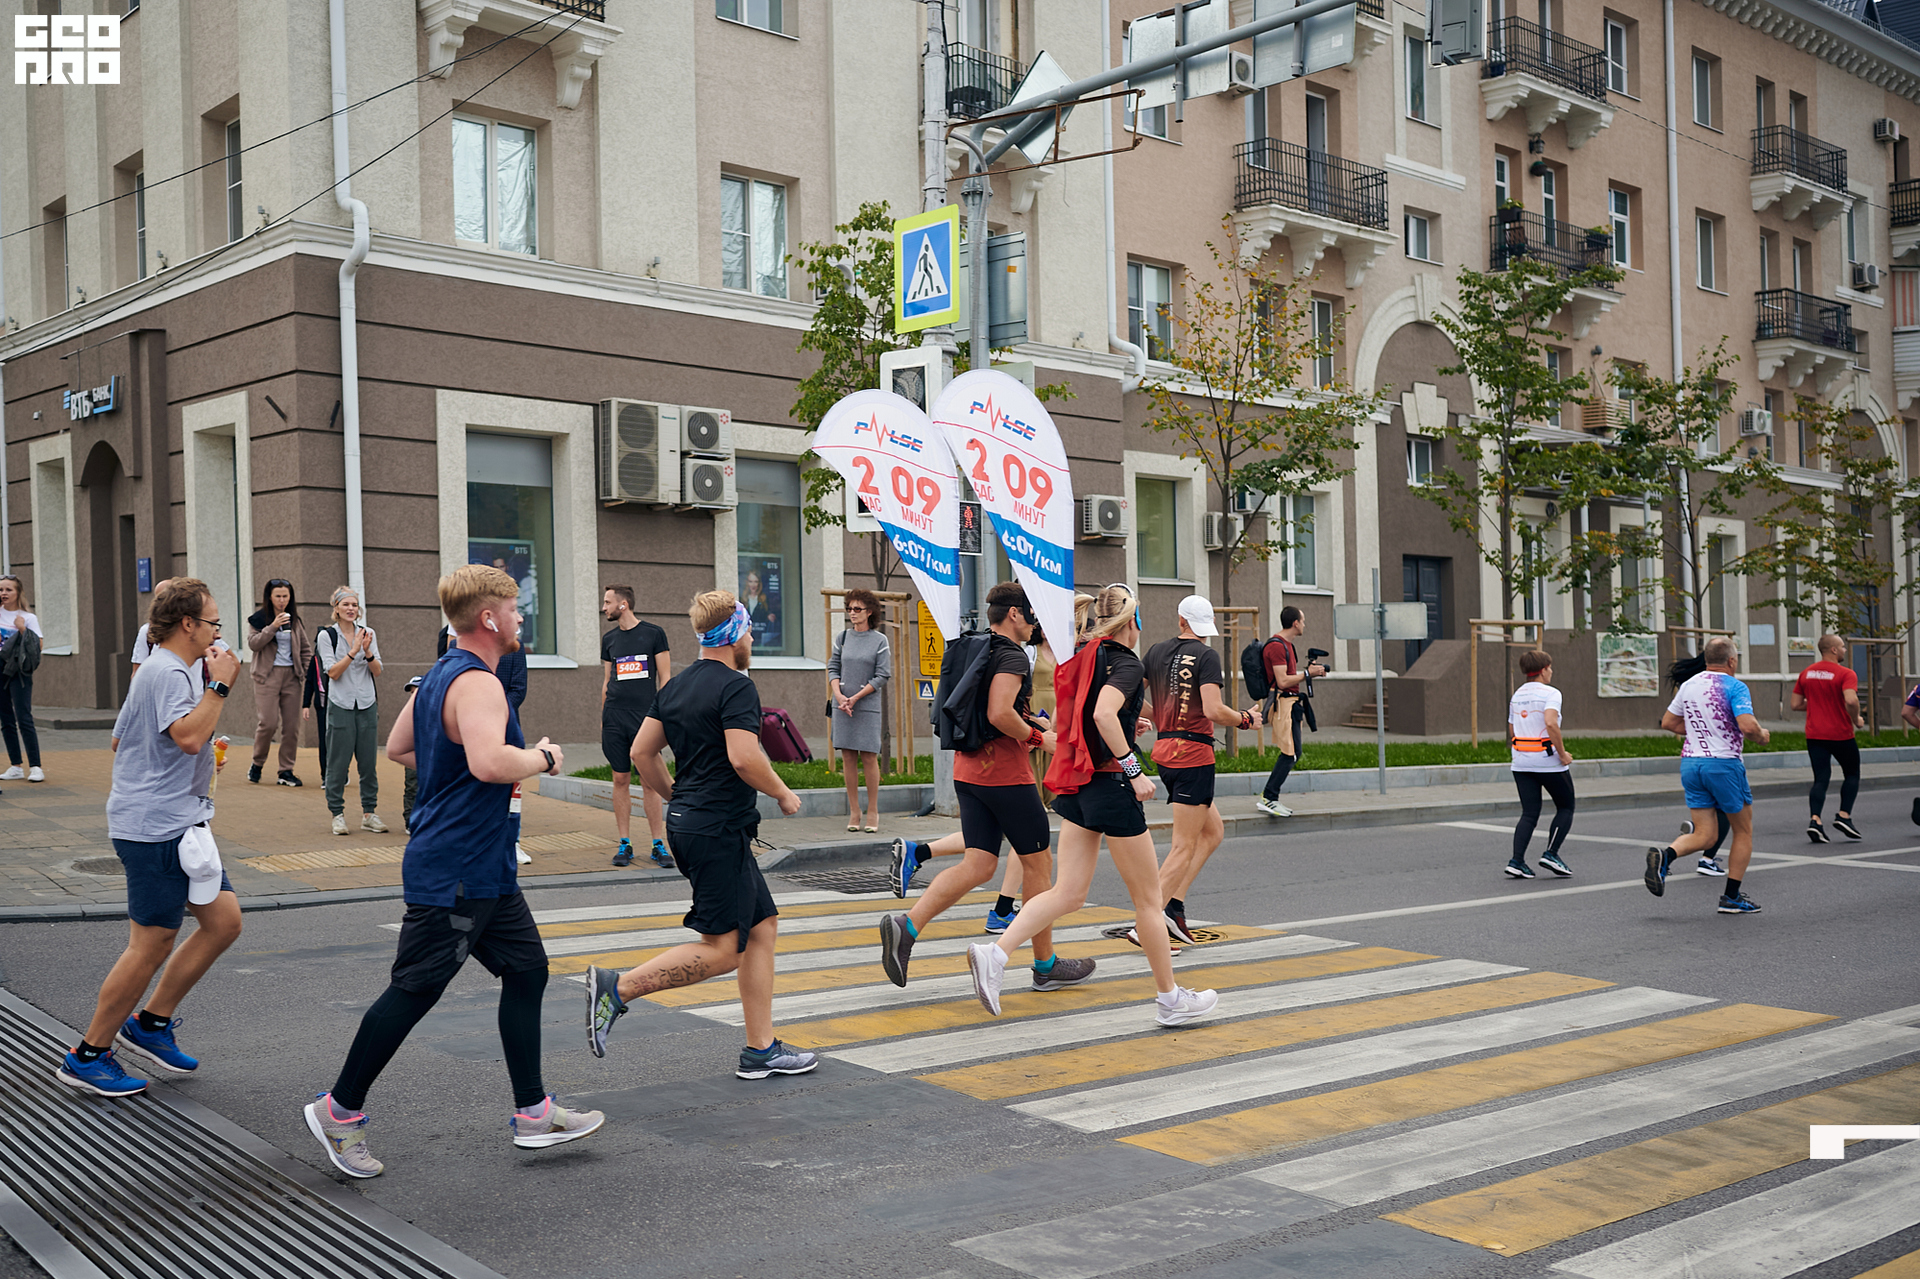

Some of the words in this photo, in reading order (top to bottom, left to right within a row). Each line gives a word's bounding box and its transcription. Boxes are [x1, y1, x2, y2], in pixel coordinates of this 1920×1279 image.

[70, 390, 92, 420] ВТБ
[92, 384, 111, 402] БАНК
[852, 455, 880, 496] 2
[890, 466, 941, 516] 09
[965, 437, 990, 482] 2
[1002, 453, 1053, 510] 09
[901, 506, 934, 533] МИНУТ
[619, 662, 641, 673] 5402
